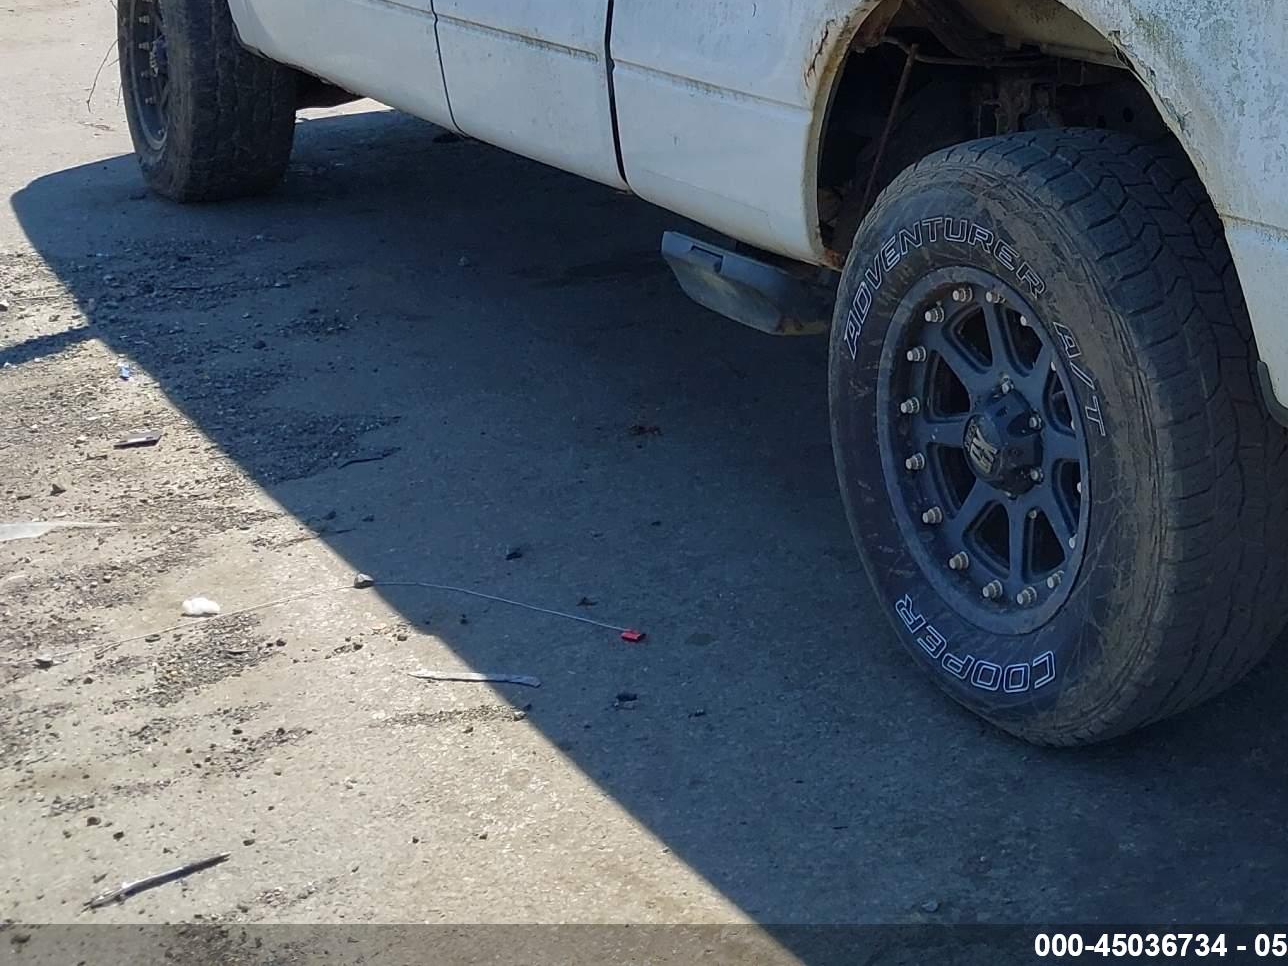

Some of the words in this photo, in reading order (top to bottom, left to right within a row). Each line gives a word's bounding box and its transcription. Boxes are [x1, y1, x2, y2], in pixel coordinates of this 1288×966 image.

[843, 216, 1047, 361] ADVENTURER
[1052, 321, 1107, 438] A/T
[895, 593, 1057, 694] COOPER
